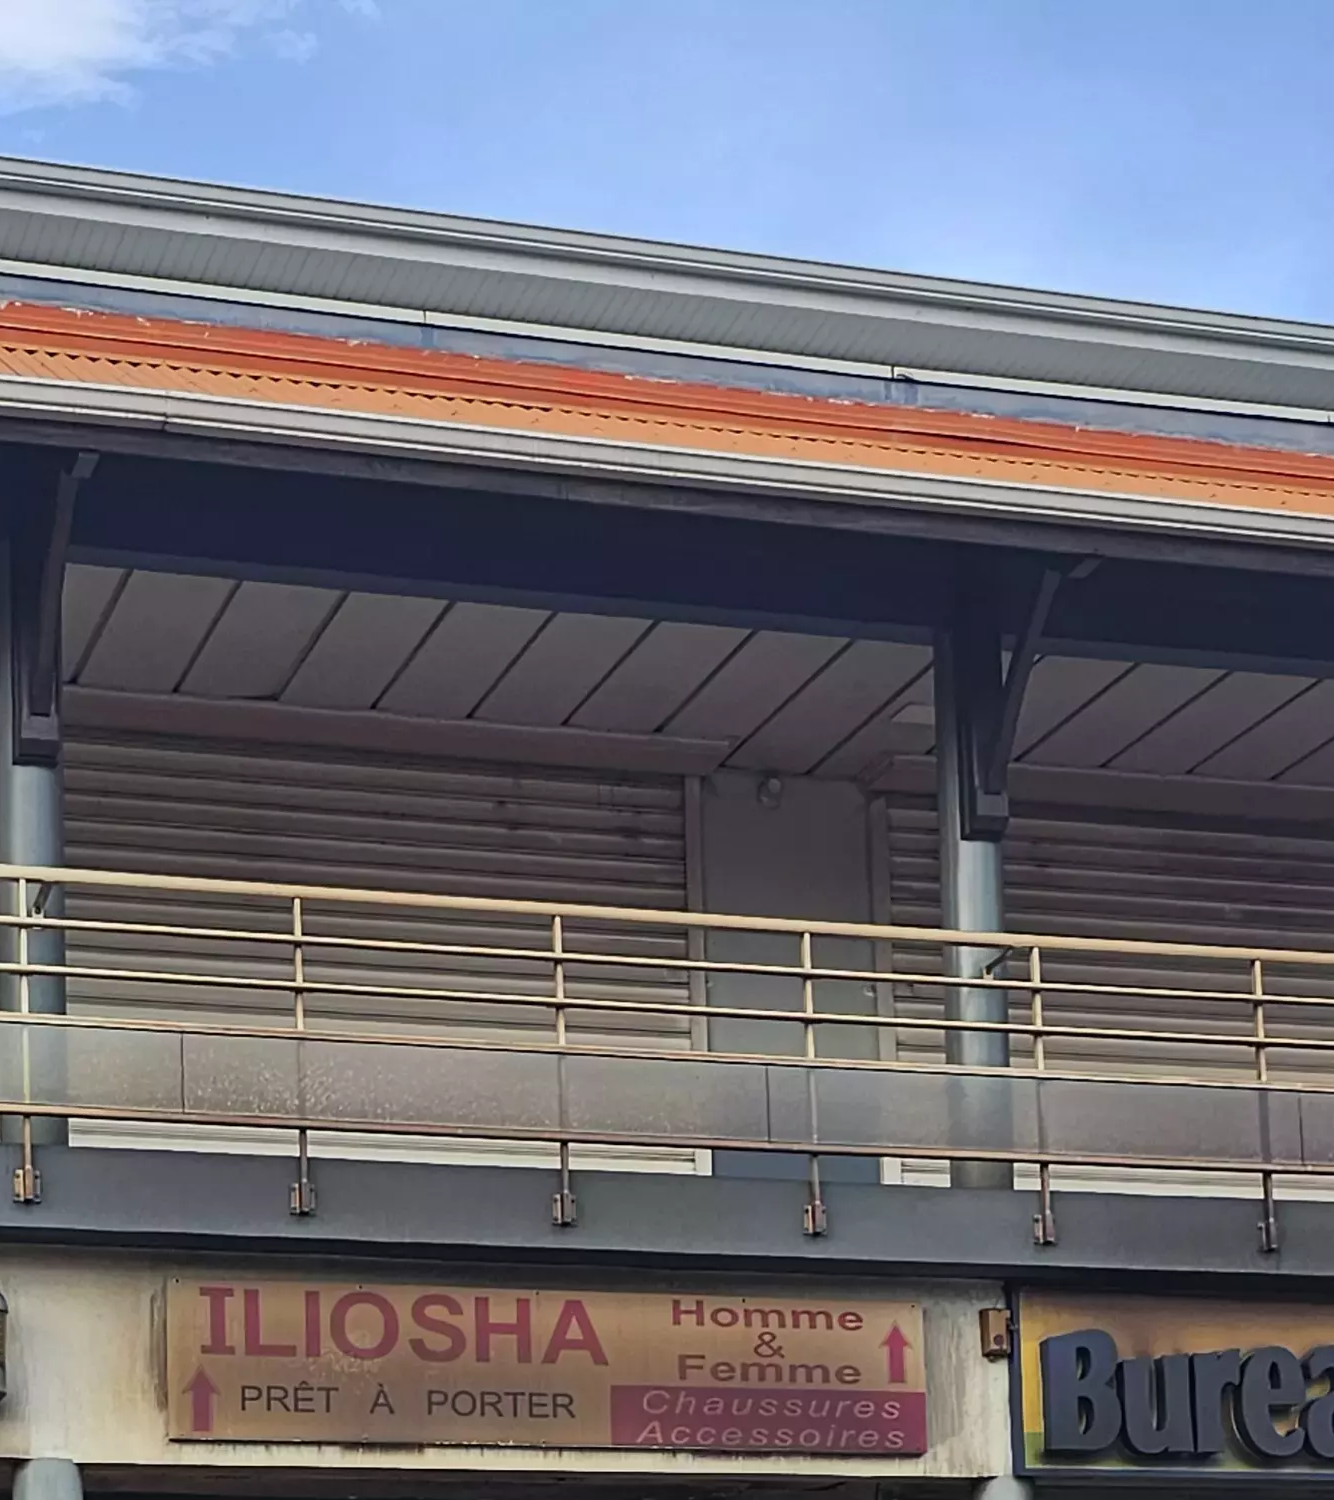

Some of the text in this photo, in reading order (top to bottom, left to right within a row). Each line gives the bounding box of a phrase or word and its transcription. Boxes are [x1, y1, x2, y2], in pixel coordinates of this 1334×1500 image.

[199, 1286, 609, 1366] ILIOSHA
[671, 1300, 864, 1331] Homme
[753, 1331, 786, 1359] &
[677, 1354, 863, 1385] Femme
[240, 1381, 577, 1419] PRÊT À PORTER
[642, 1390, 901, 1420] Chaussures
[636, 1421, 906, 1449] Accessoires
